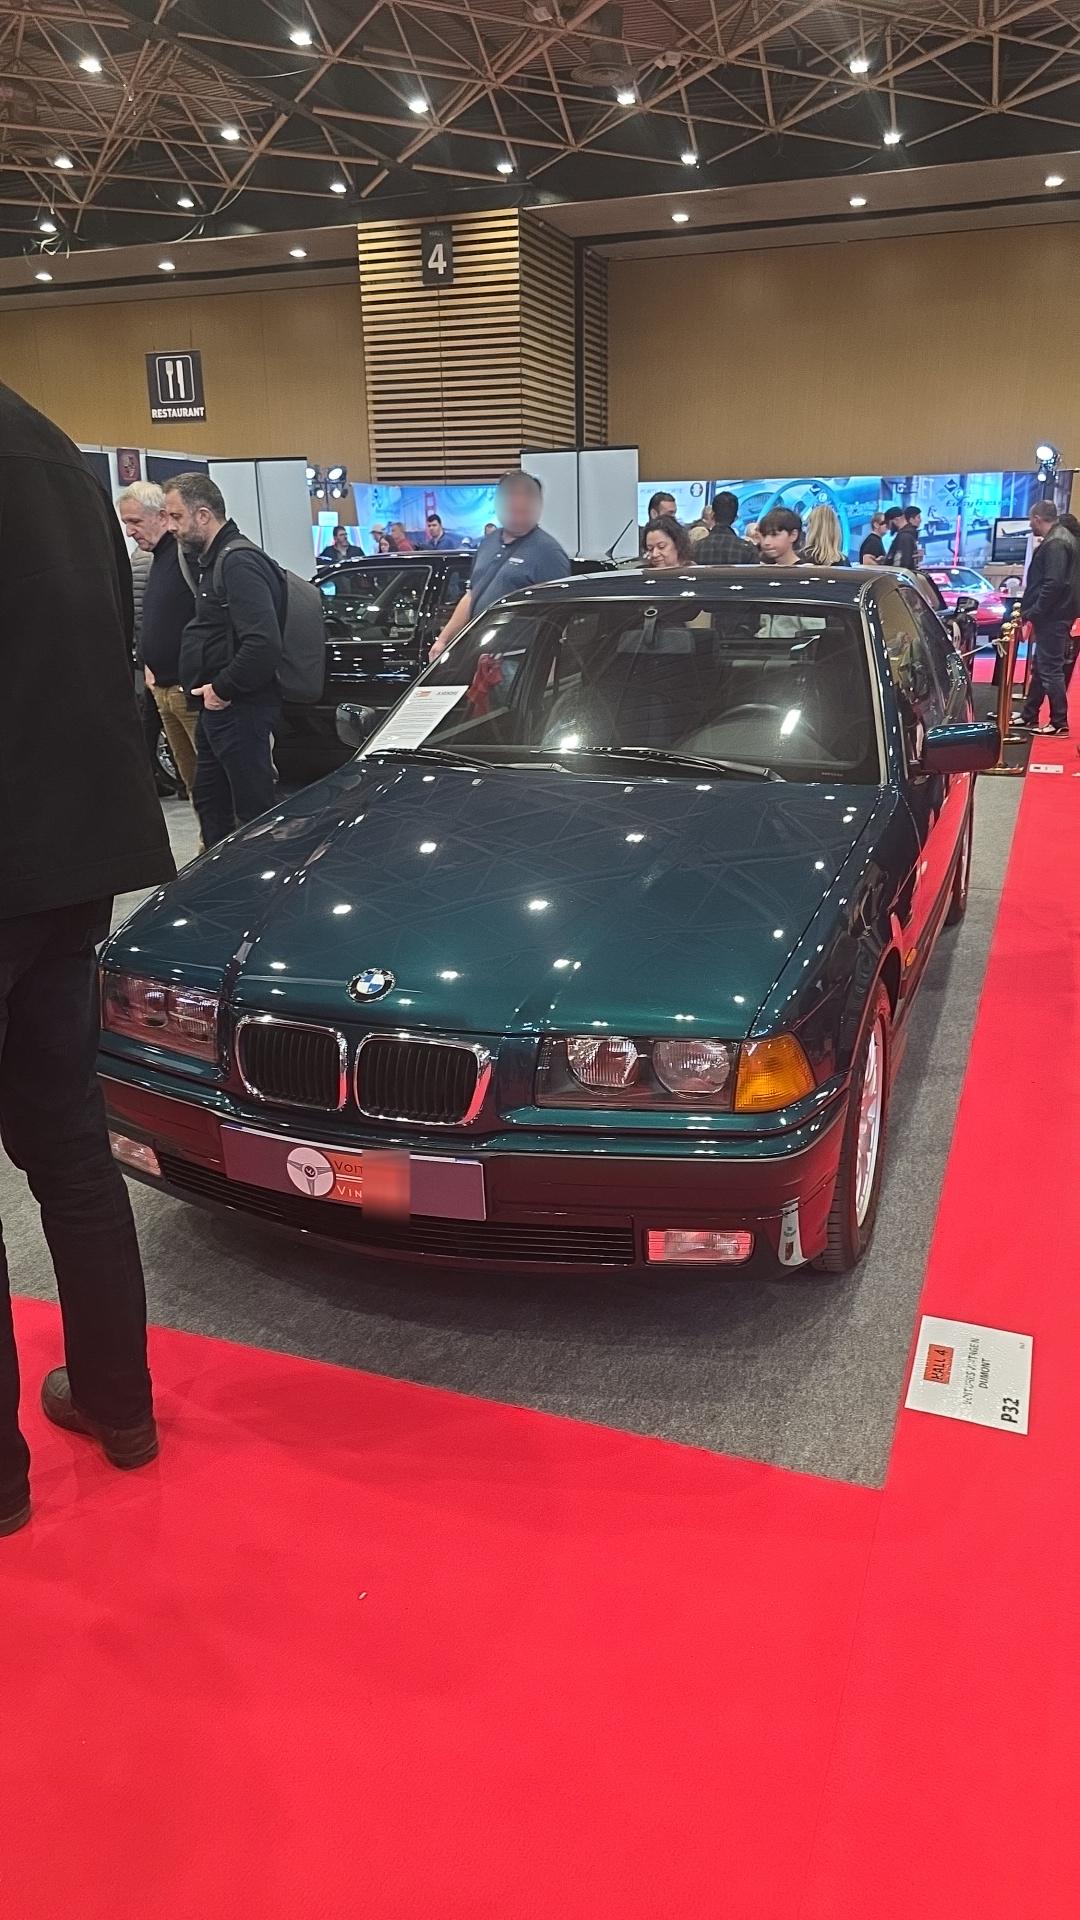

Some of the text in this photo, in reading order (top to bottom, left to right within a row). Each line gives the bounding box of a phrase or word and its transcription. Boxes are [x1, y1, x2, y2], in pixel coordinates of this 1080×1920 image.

[428, 243, 447, 275] 4
[151, 406, 205, 419] RESTAURANT
[337, 1185, 362, 1198] VIN
[931, 1359, 946, 1381] HALL
[979, 1358, 991, 1389] DUMONT
[1001, 1397, 1020, 1424] P32
